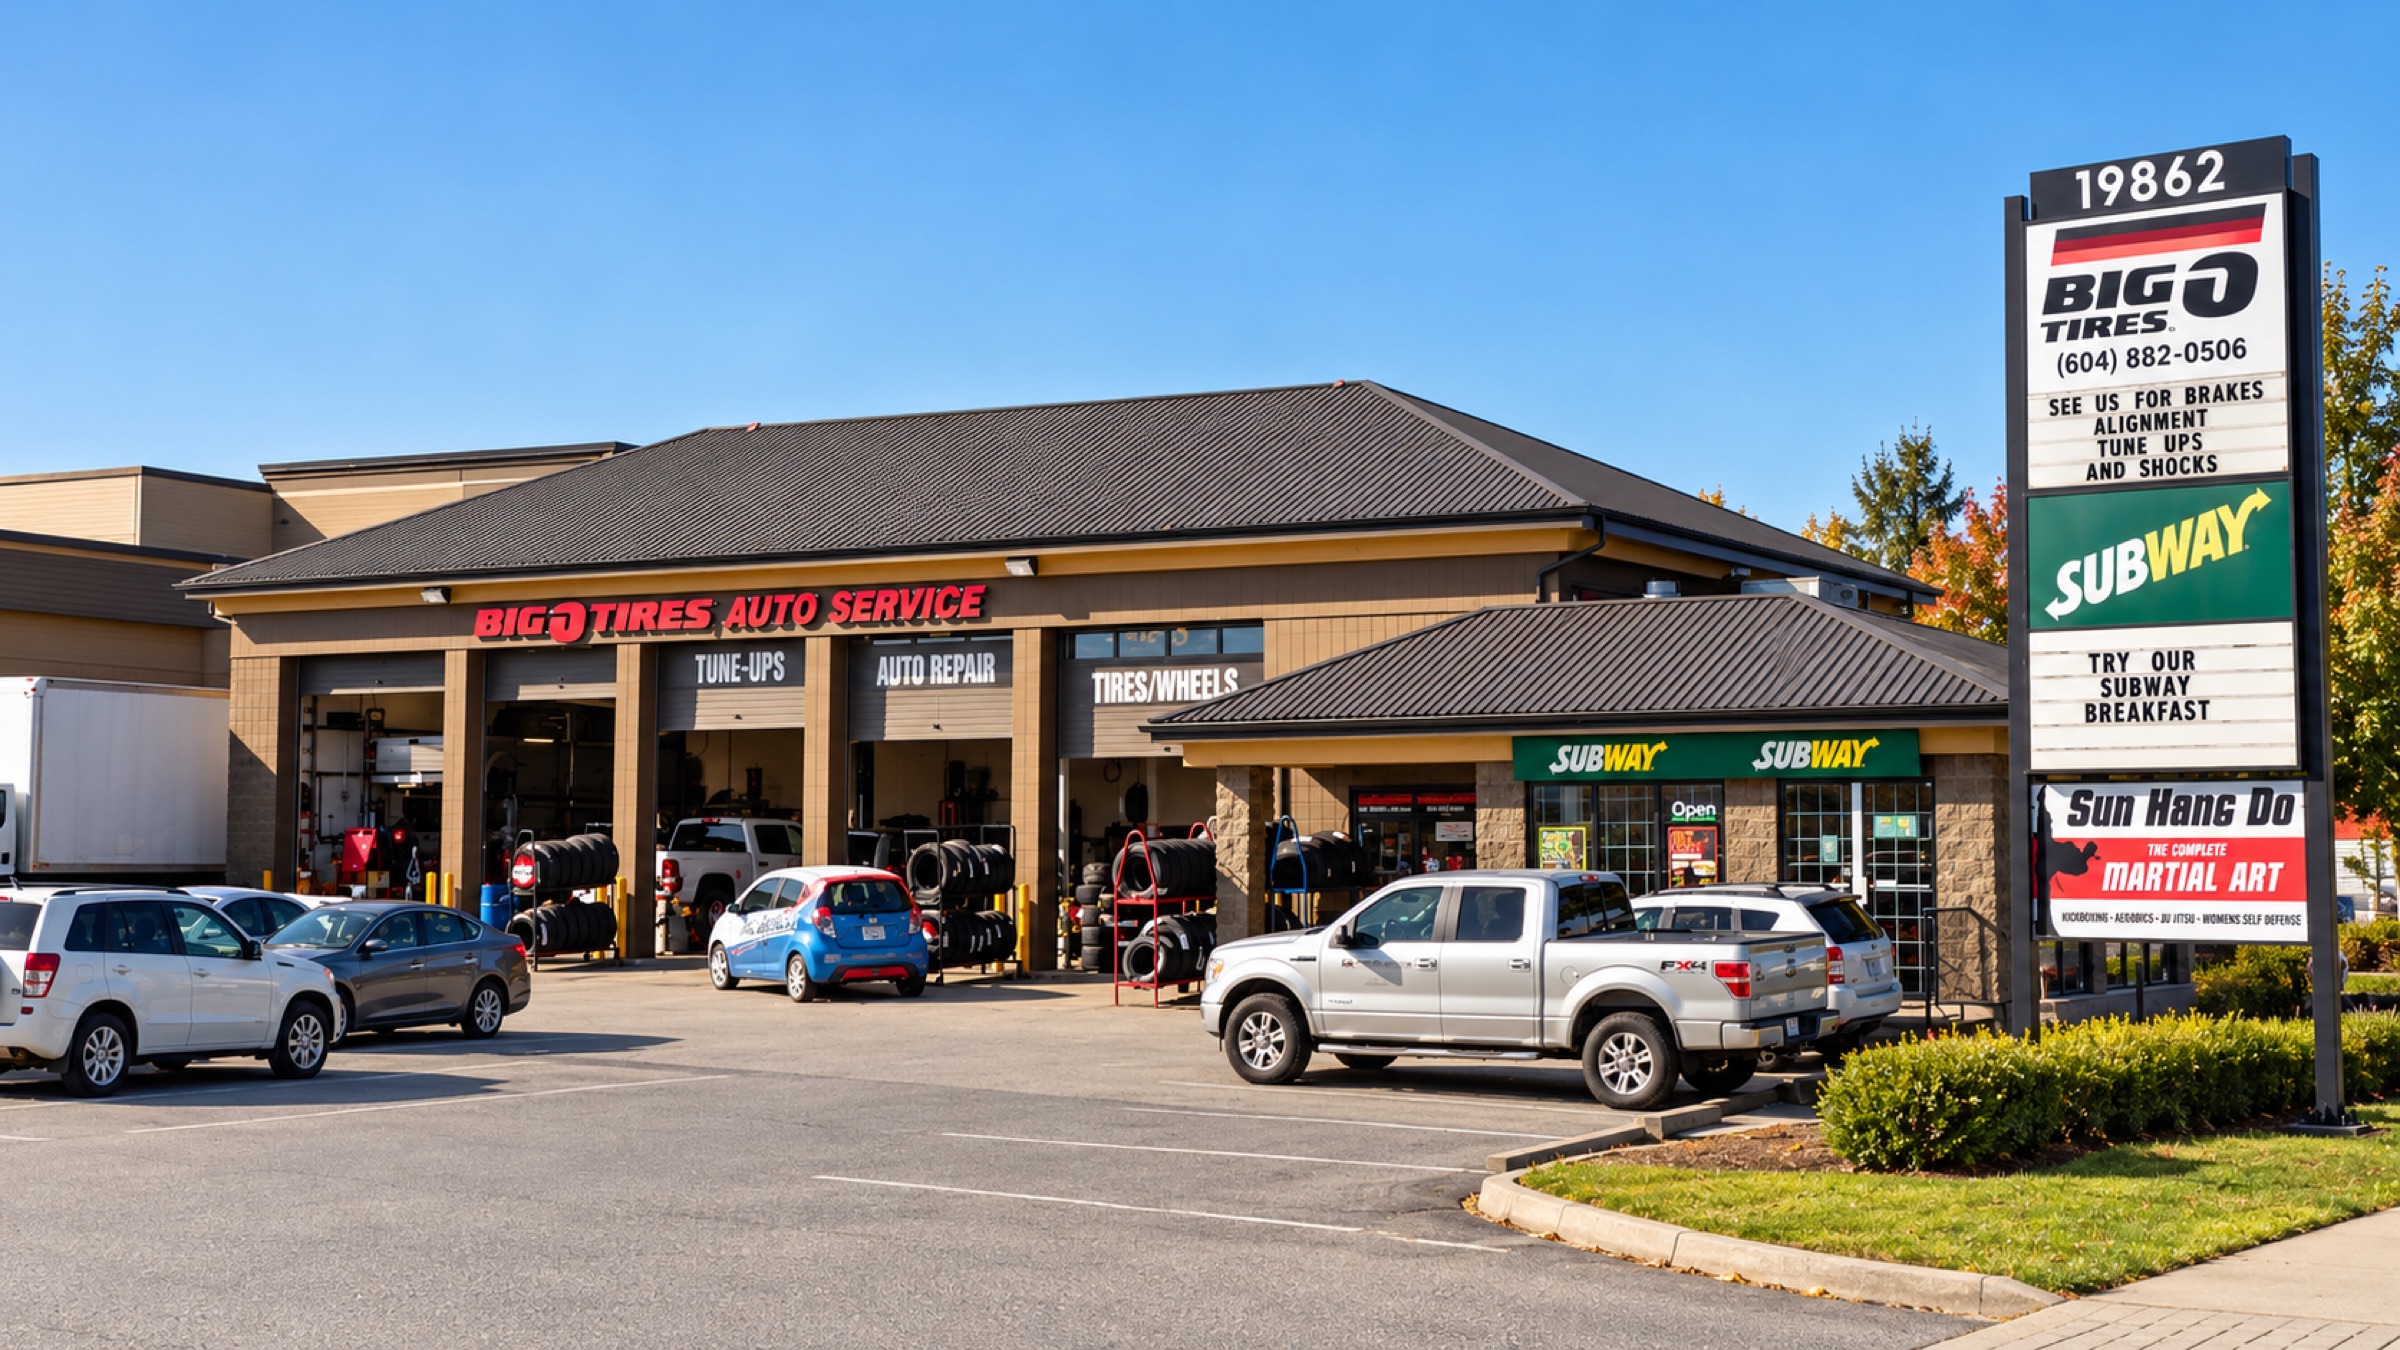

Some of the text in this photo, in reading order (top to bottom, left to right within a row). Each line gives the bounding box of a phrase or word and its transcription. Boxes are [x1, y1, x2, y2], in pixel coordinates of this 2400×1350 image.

[2075, 149, 2226, 210] 19862
[2042, 251, 2259, 319] BIG O
[2040, 310, 2168, 343] TIRES
[2056, 337, 2247, 379] (604) 882-0506
[2049, 380, 2263, 417] SEE US FOR BRAKES
[2094, 409, 2208, 435] ALIGNMENT
[2097, 432, 2203, 458] TUNE UPS
[2086, 454, 2218, 481] AND SHOCKS
[2044, 487, 2272, 622] SUBWAY
[474, 605, 549, 639] BIG
[589, 598, 715, 633] TIRES
[724, 591, 819, 629] AUTO
[828, 584, 988, 625] SERVICE
[694, 650, 787, 685] TUNE-UPS
[876, 652, 996, 688] AUTO REPAIR
[2088, 650, 2196, 673] TRY OUR
[1091, 666, 1239, 704] TIRES/WHEELS
[2100, 675, 2191, 698] SUBWAY
[2085, 699, 2210, 723] BREAKFAST
[1549, 740, 1668, 775] SUBWAY
[1752, 736, 1880, 772] SUBWAY
[1671, 801, 1716, 822] Open
[2066, 789, 2136, 827] Sun
[2246, 787, 2296, 826] Do
[2147, 842, 2228, 857] THE COMPLETE
[2102, 861, 2285, 892] MARTIAL ART
[2242, 913, 2263, 925] SELF
[1660, 960, 1708, 971] FX4
